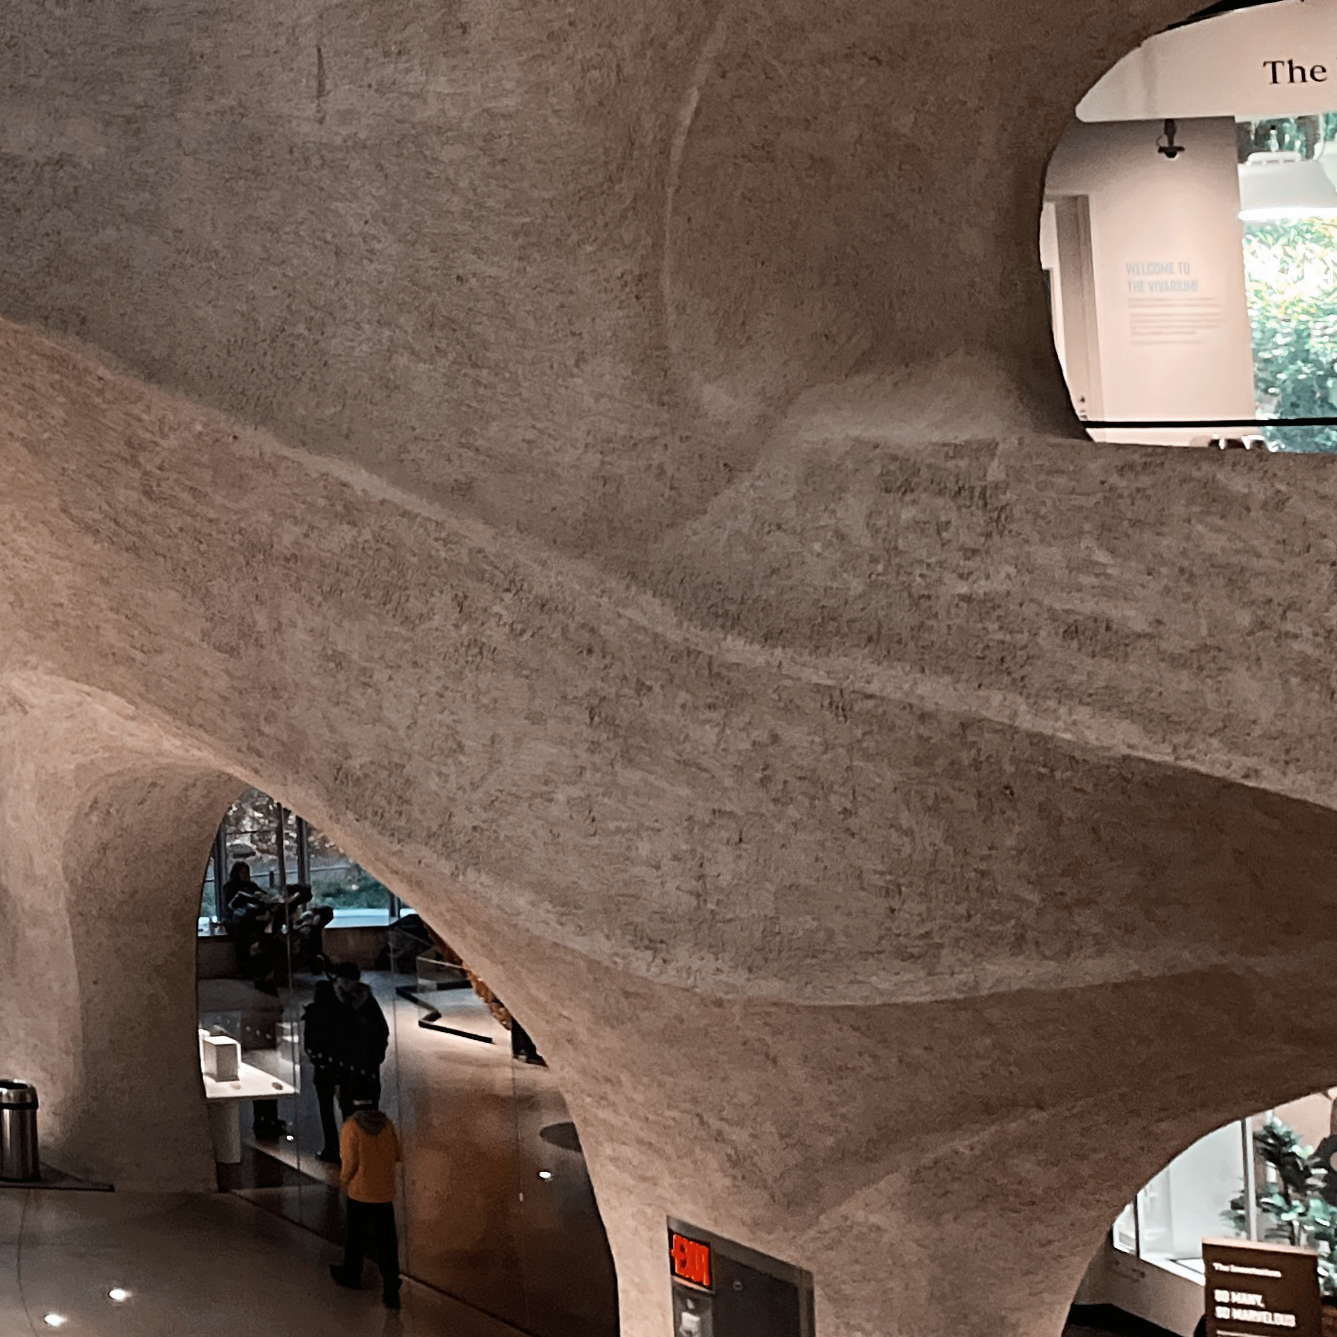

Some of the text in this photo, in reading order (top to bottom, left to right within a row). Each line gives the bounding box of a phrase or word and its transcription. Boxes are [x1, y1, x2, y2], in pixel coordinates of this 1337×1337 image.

[1263, 59, 1327, 84] The
[1126, 262, 1189, 275] WELCOME TO
[1127, 280, 1145, 292] THE
[672, 1234, 710, 1286] EXIT
